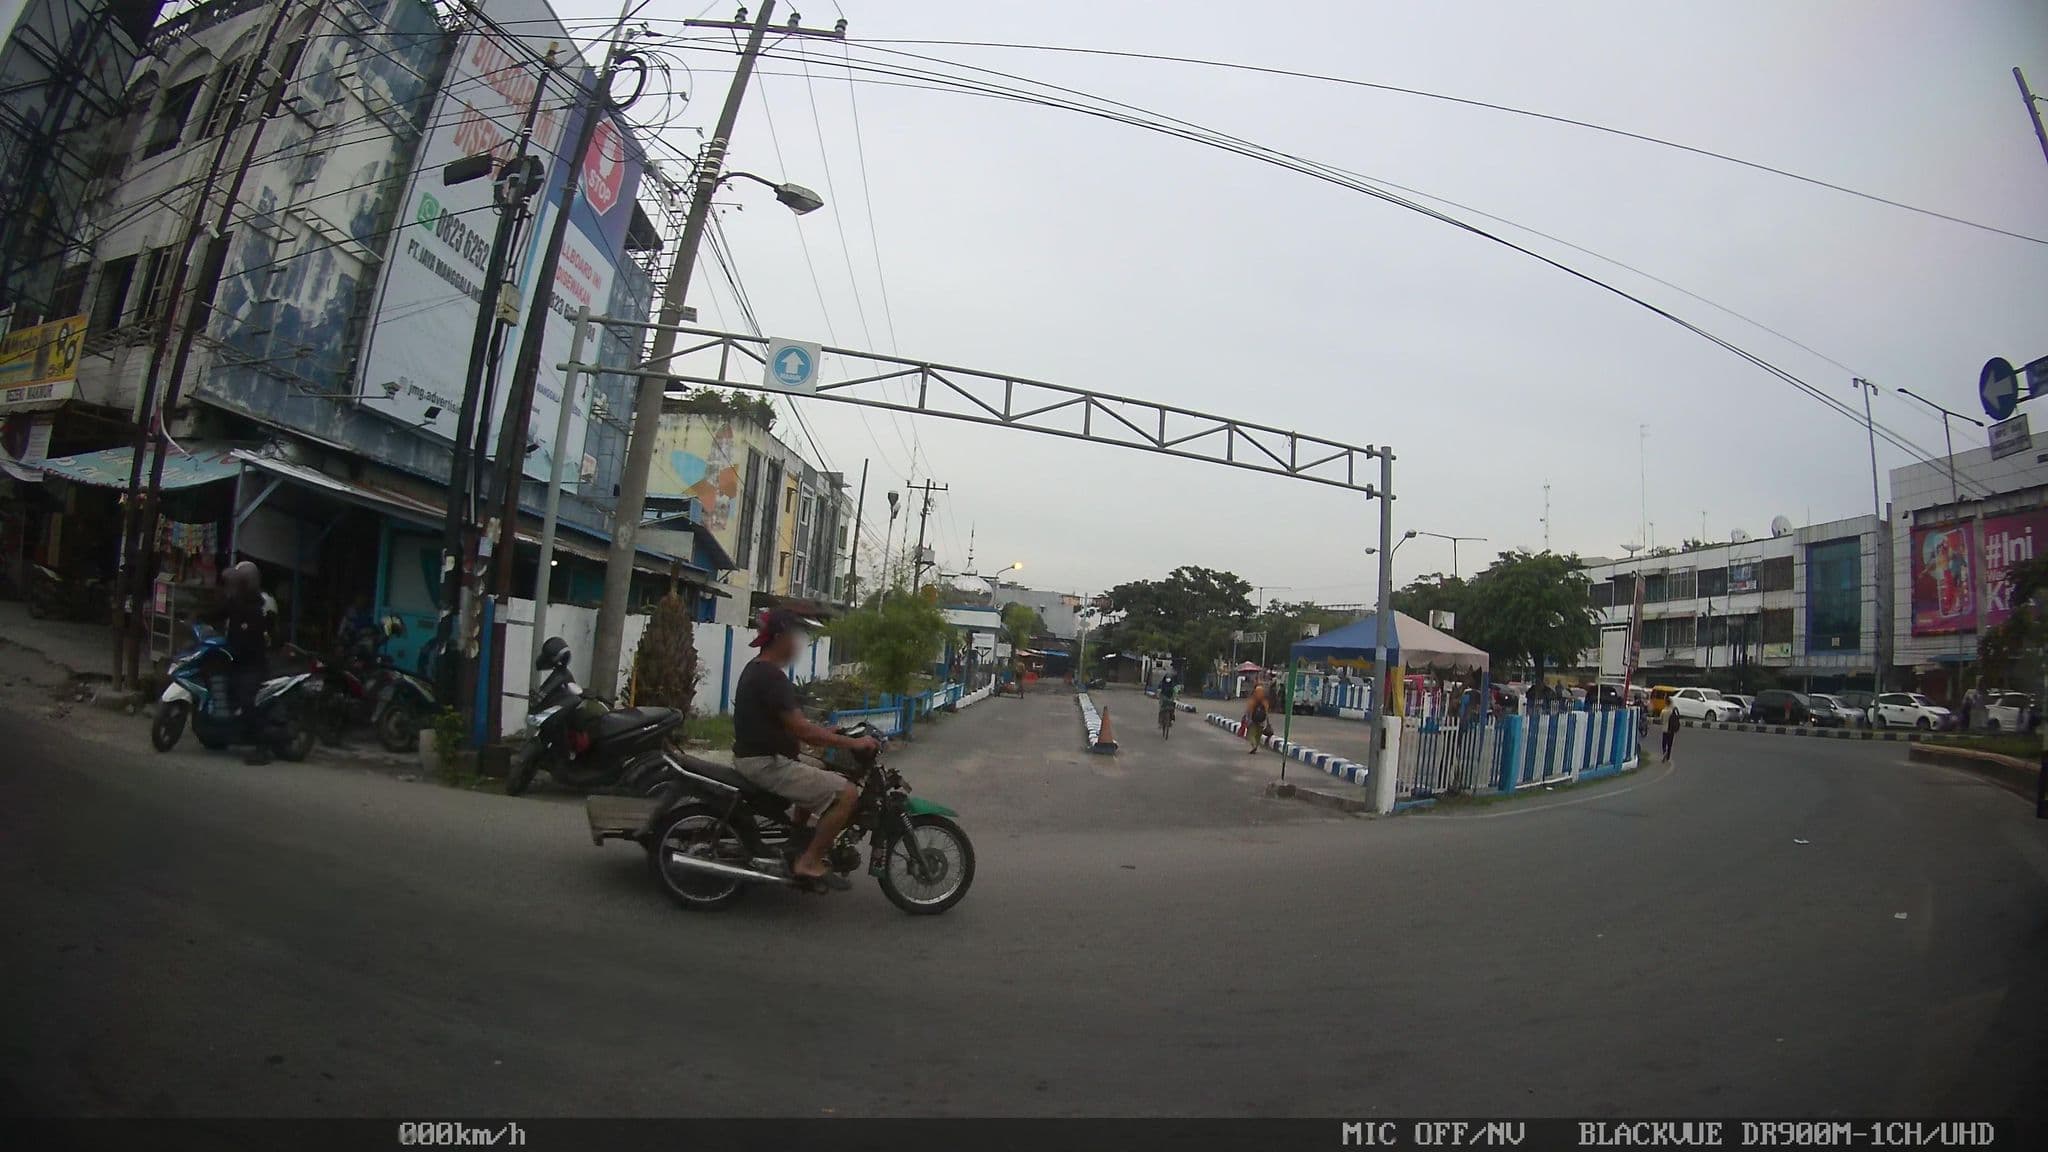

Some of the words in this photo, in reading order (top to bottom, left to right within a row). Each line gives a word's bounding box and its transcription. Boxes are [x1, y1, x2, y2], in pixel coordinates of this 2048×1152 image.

[472, 26, 536, 121] BILLBOAR
[588, 169, 612, 204] STOP
[436, 207, 466, 253] 0823
[463, 229, 490, 272] 6252
[561, 242, 593, 281] LLBOARD
[1985, 526, 2033, 569] #Ini
